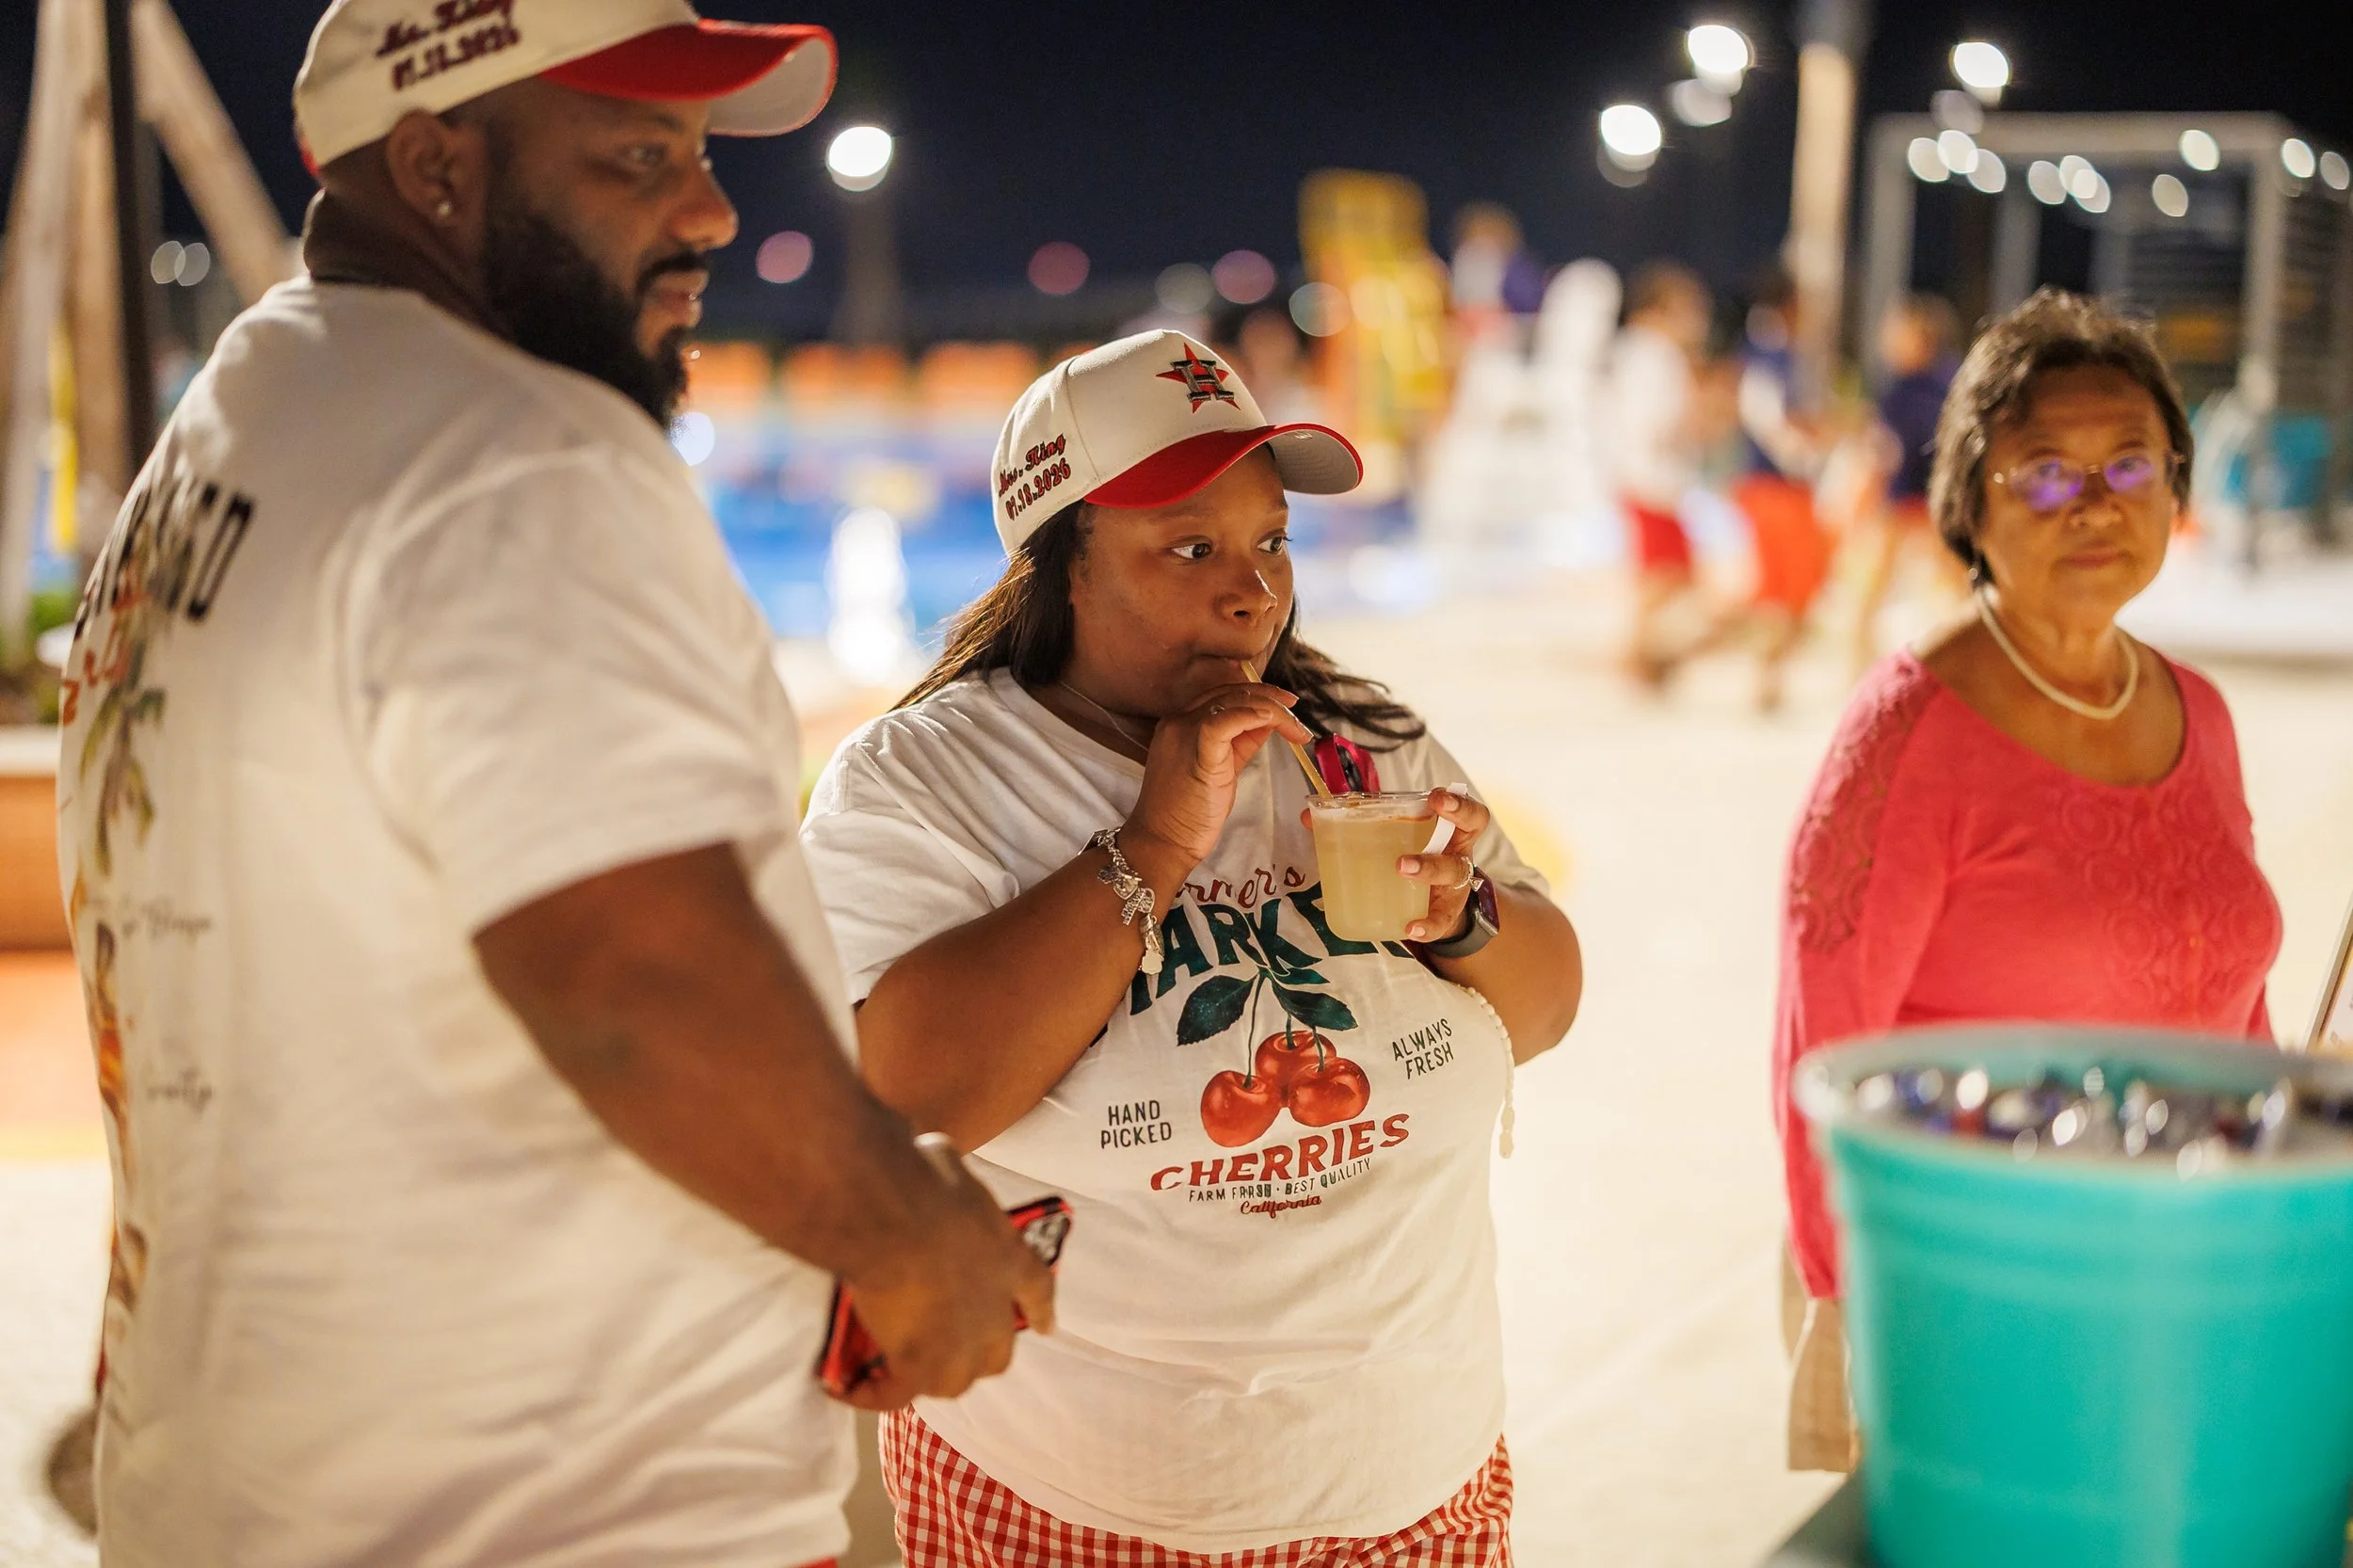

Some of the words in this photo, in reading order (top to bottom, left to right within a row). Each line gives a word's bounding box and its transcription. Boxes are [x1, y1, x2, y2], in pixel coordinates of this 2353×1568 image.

[1025, 433, 1065, 471] King
[1176, 863, 1306, 909] rmer's
[1392, 1018, 1452, 1062] ALWAYS
[1405, 1041, 1454, 1080] FRESH
[1108, 1099, 1160, 1127] HAND
[1100, 1121, 1172, 1149] PICKED
[1150, 1113, 1409, 1191] CHERRIES
[1189, 1188, 1226, 1202] FARM
[1285, 1177, 1316, 1195] BEST
[1320, 1158, 1370, 1188] QUALITY
[1241, 1194, 1322, 1219] California
